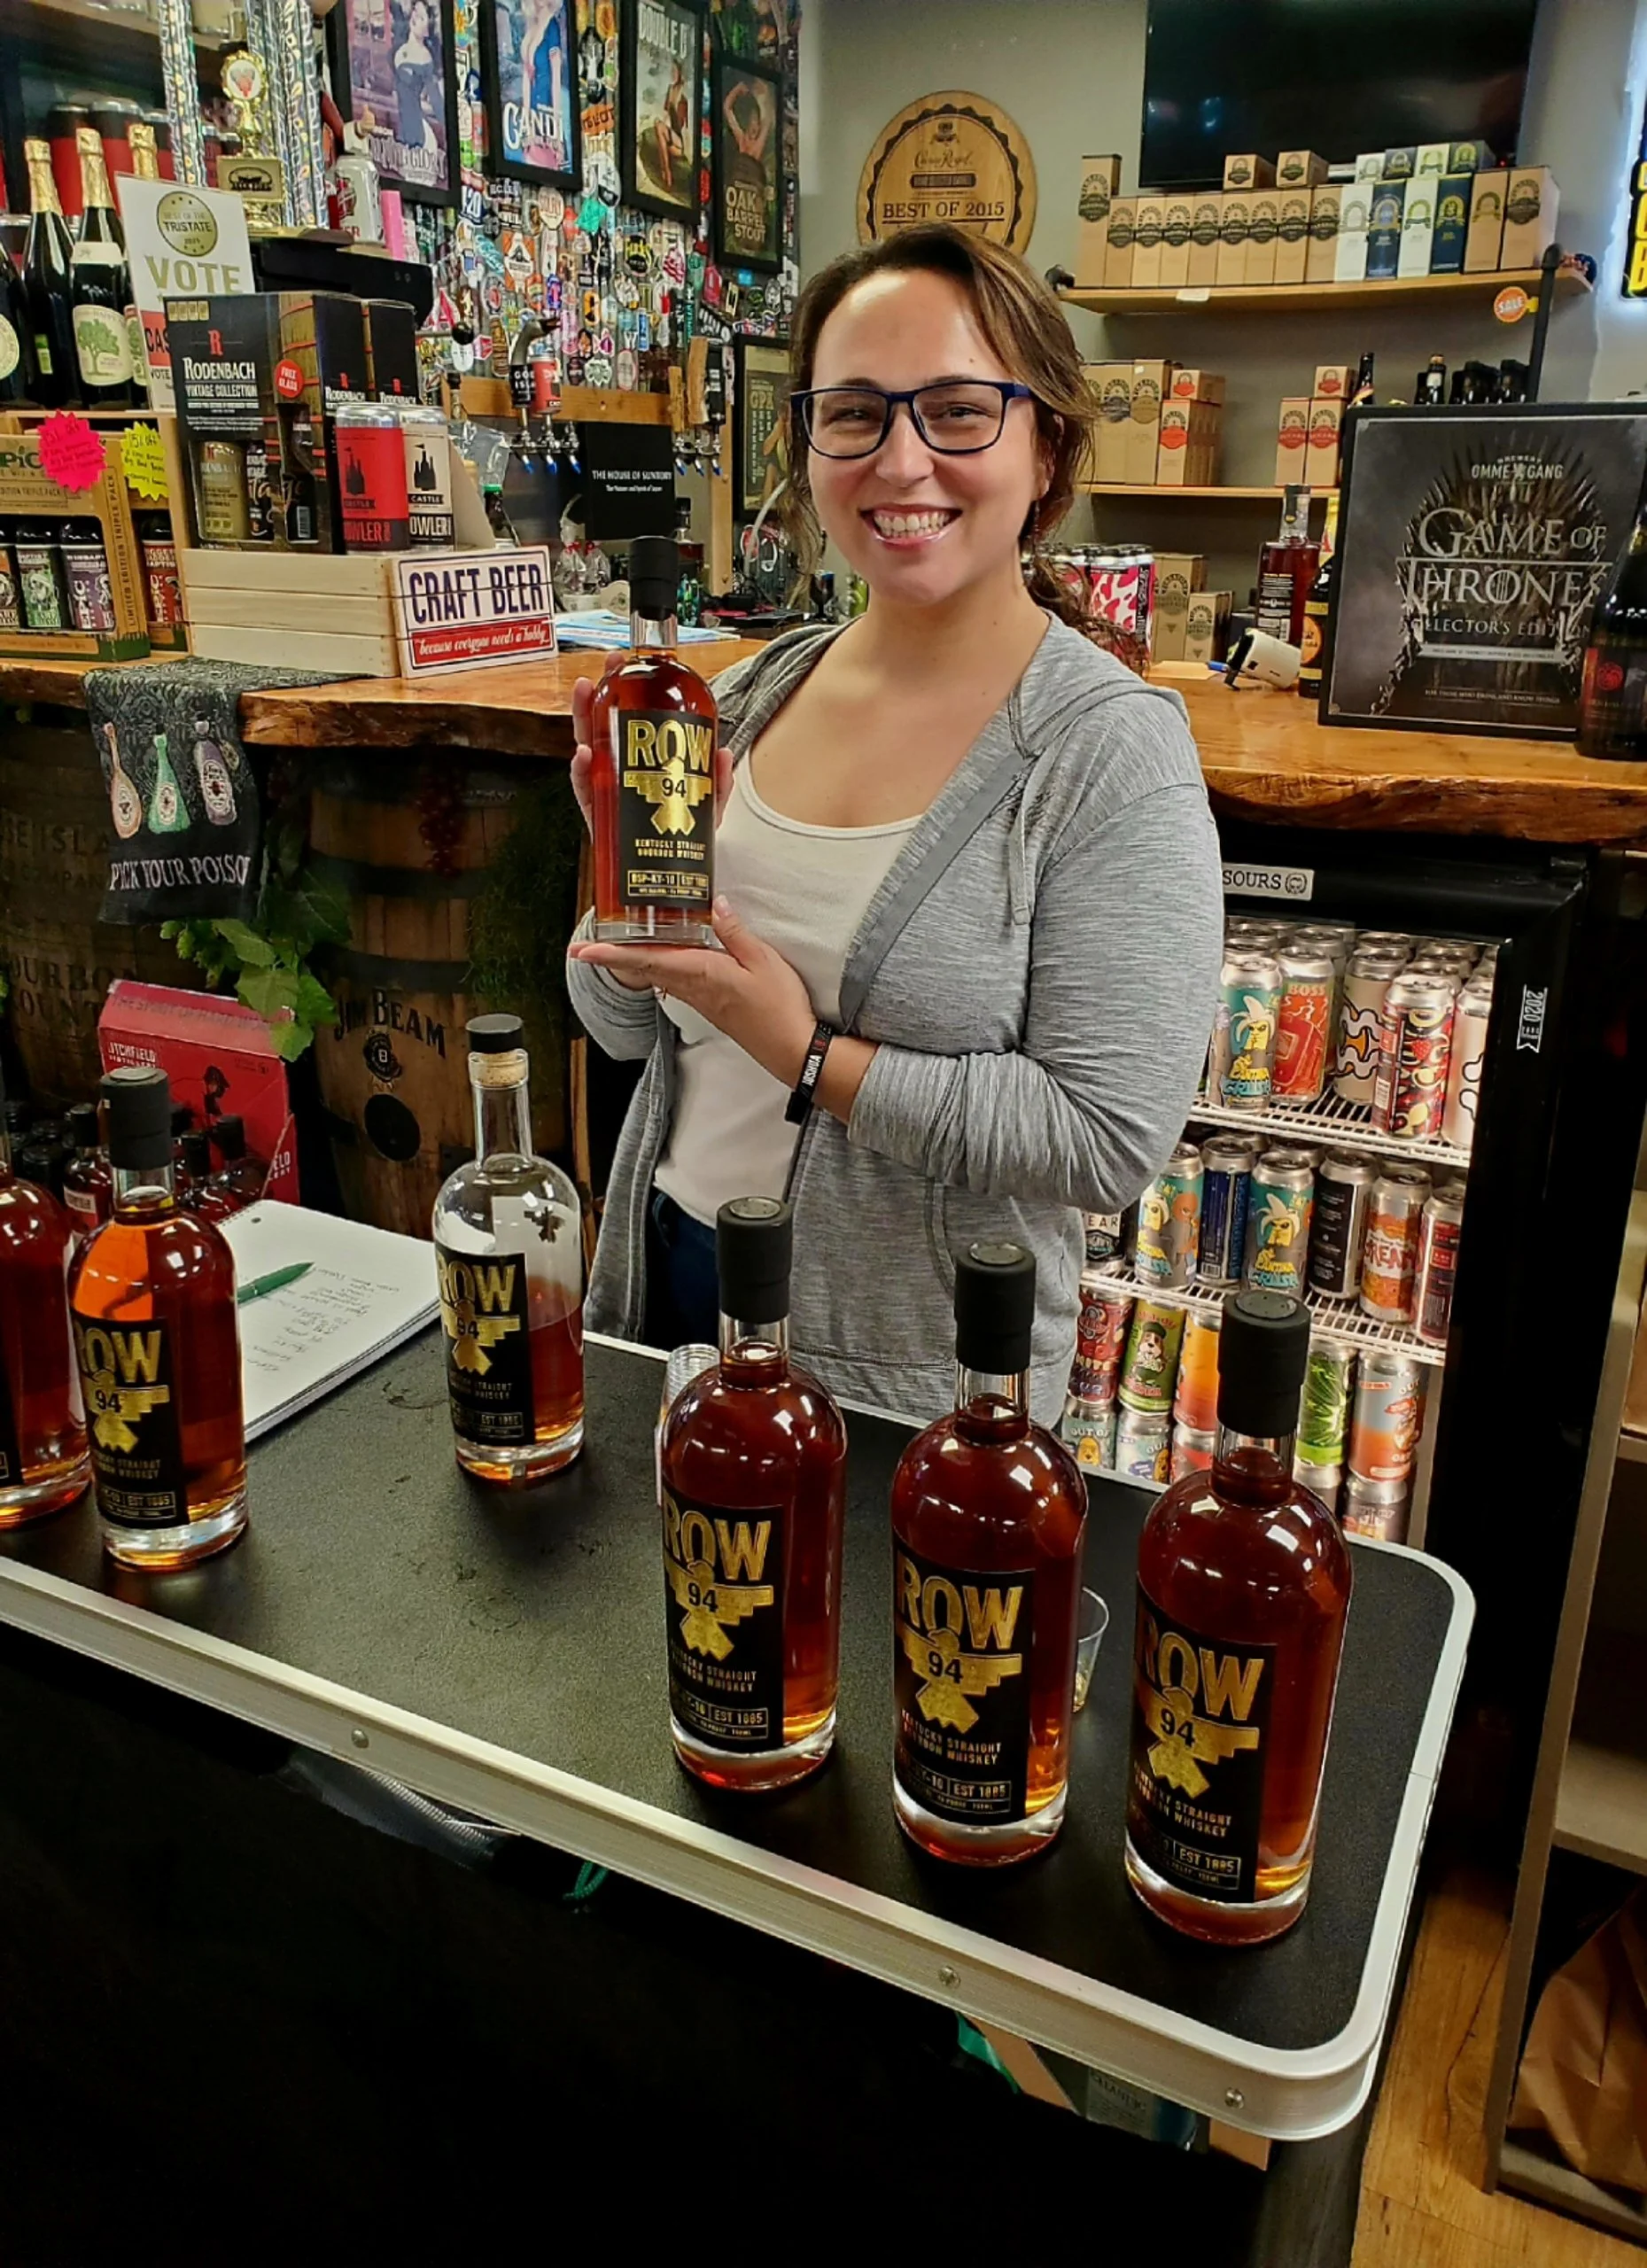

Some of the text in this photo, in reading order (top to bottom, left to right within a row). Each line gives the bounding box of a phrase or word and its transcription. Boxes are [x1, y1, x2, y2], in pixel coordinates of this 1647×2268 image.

[726, 187, 757, 212] OAK
[882, 201, 1005, 219] BEST OF 2015
[163, 221, 213, 233] TRISTATE
[726, 207, 765, 229] BARREL
[734, 224, 765, 242] STOUT
[144, 254, 243, 294] VOTE
[1497, 297, 1524, 314] SALE
[151, 369, 170, 380] VOTE
[183, 356, 256, 380] RODENBACH
[281, 367, 297, 379] FREE
[185, 384, 258, 397] VINTAGE COLLECTION
[325, 386, 365, 401] RODENBACH
[380, 392, 416, 405] RODENBACH
[592, 470, 605, 481] THE
[1418, 507, 1607, 558] GAME OF
[409, 563, 544, 624] CRAFT BEER
[1395, 556, 1610, 610] THRONES
[454, 634, 490, 654] everyone
[491, 628, 514, 645] needs
[516, 632, 522, 643] a
[522, 624, 550, 645] hobby
[627, 718, 712, 773] ROW
[661, 778, 688, 798] 94
[110, 861, 140, 891] PICK
[141, 858, 191, 888] YOUR
[1222, 869, 1281, 890] SOURS
[1289, 984, 1327, 996] BOSS
[1523, 990, 1544, 1022] 2020
[334, 989, 447, 1060] JIM BEAM
[272, 1151, 291, 1170] ELD
[95, 1390, 122, 1412] 94
[664, 1490, 772, 1581] ROW
[688, 1582, 719, 1612] 94
[897, 1550, 1024, 1651] ROW
[928, 1651, 964, 1684] 94
[1137, 1605, 1265, 1721] ROW
[707, 1666, 757, 1682] STRAIGHT
[707, 1676, 754, 1693] WHISKEY
[713, 1709, 733, 1724] EST
[1160, 1707, 1196, 1748] 94
[946, 1737, 1002, 1753] STRAIGHT
[946, 1751, 998, 1766] WHISKEY
[953, 1783, 975, 1798] EST
[1175, 1800, 1232, 1827] STRAIGHT
[1174, 1812, 1227, 1837] WHISKEY
[1179, 1847, 1201, 1866] EST
